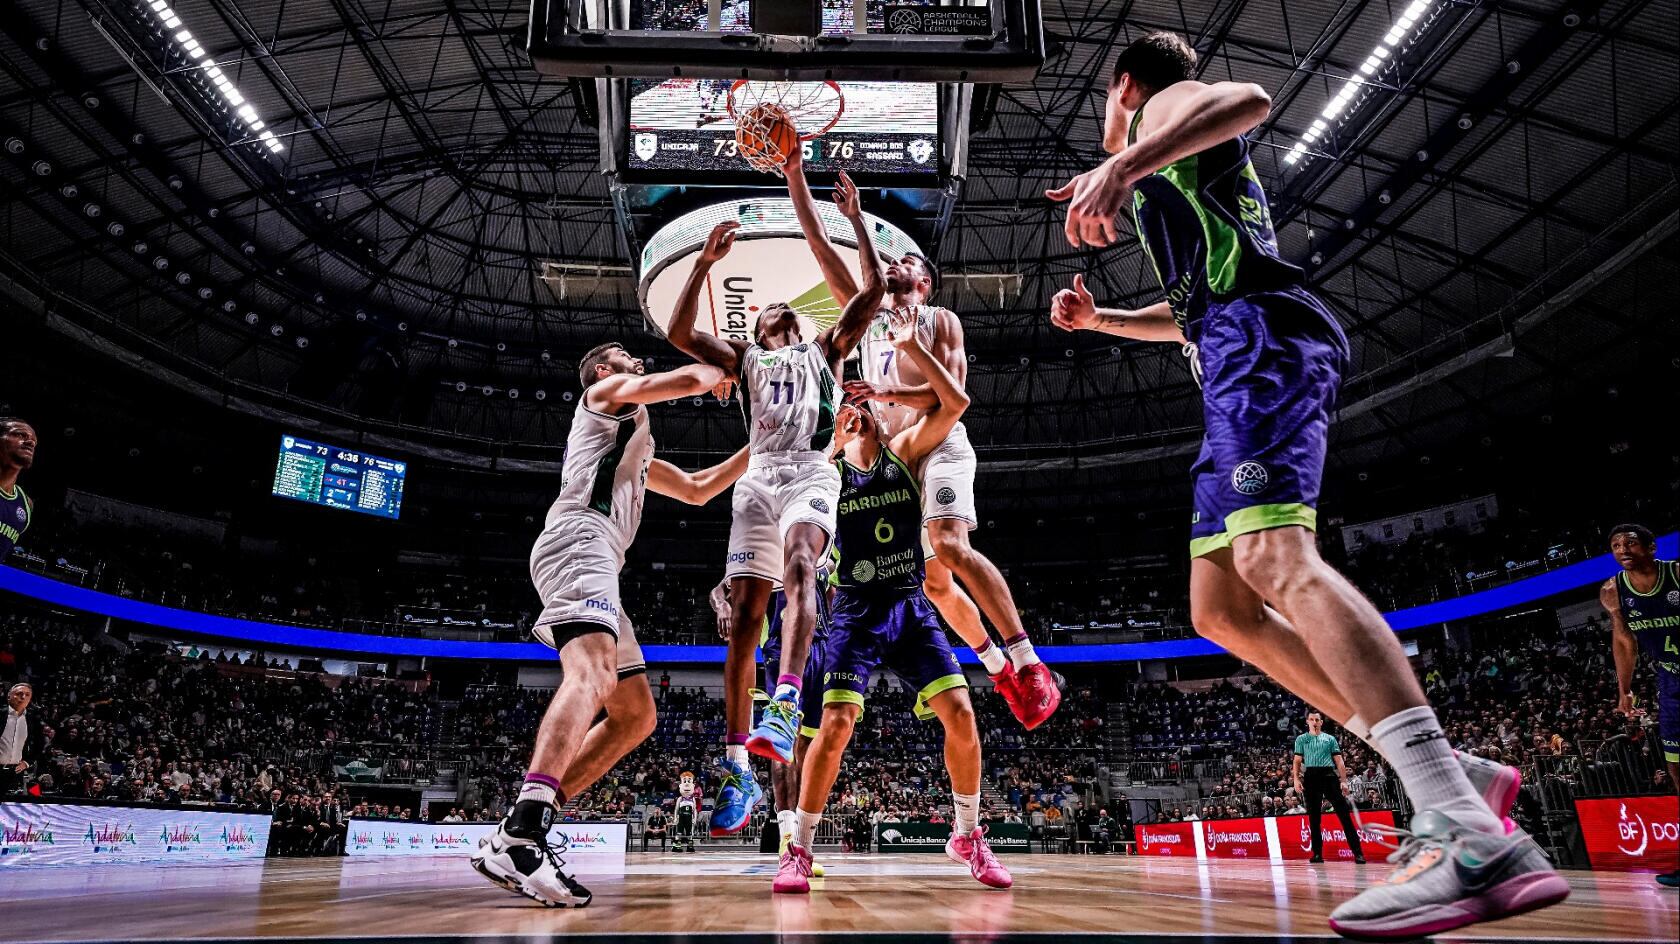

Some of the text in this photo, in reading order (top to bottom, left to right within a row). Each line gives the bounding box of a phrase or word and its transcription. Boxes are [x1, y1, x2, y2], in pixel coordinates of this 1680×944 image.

[923, 19, 987, 27] CHAMPIONS
[661, 143, 699, 151] UNICAJA
[713, 139, 738, 157] 73
[829, 141, 855, 159] 76
[880, 350, 894, 376] 7
[769, 380, 795, 405] 11
[316, 446, 328, 455] 73
[363, 457, 375, 466] 76
[839, 488, 911, 515] SARDINIA
[874, 517, 894, 544] 6
[1664, 635, 1679, 656] 4
[900, 835, 926, 845] Unicaja
[1007, 837, 1028, 845] Banco
